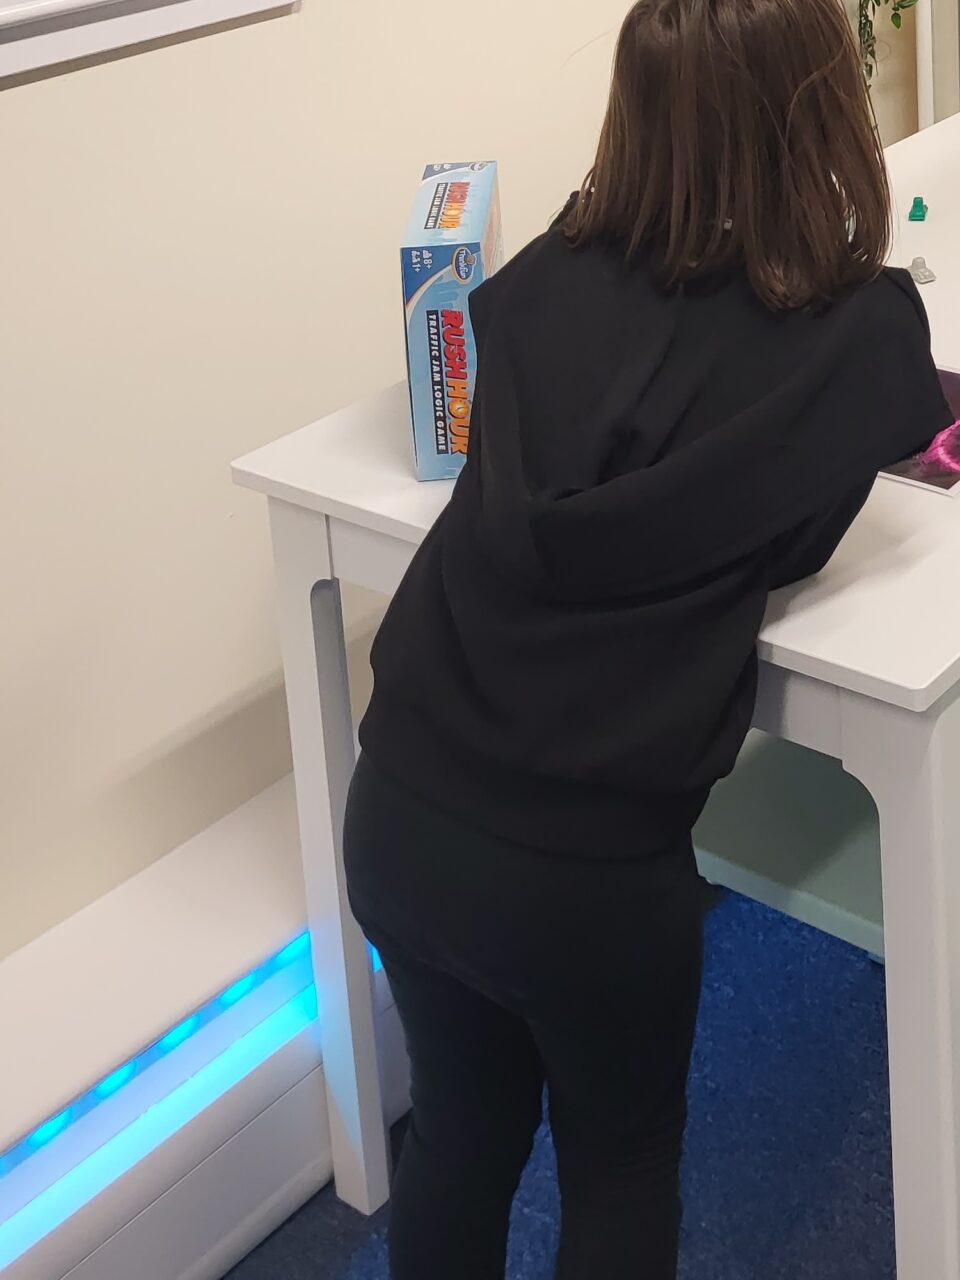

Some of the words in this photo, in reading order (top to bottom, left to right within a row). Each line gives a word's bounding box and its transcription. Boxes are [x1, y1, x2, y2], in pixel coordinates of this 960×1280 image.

[428, 314, 440, 357] TRAFFIC
[440, 308, 468, 380] RUSH
[431, 360, 441, 381] JAM
[434, 385, 444, 418] LOGIC
[446, 379, 471, 456] HOUR
[436, 420, 446, 452] GAME
